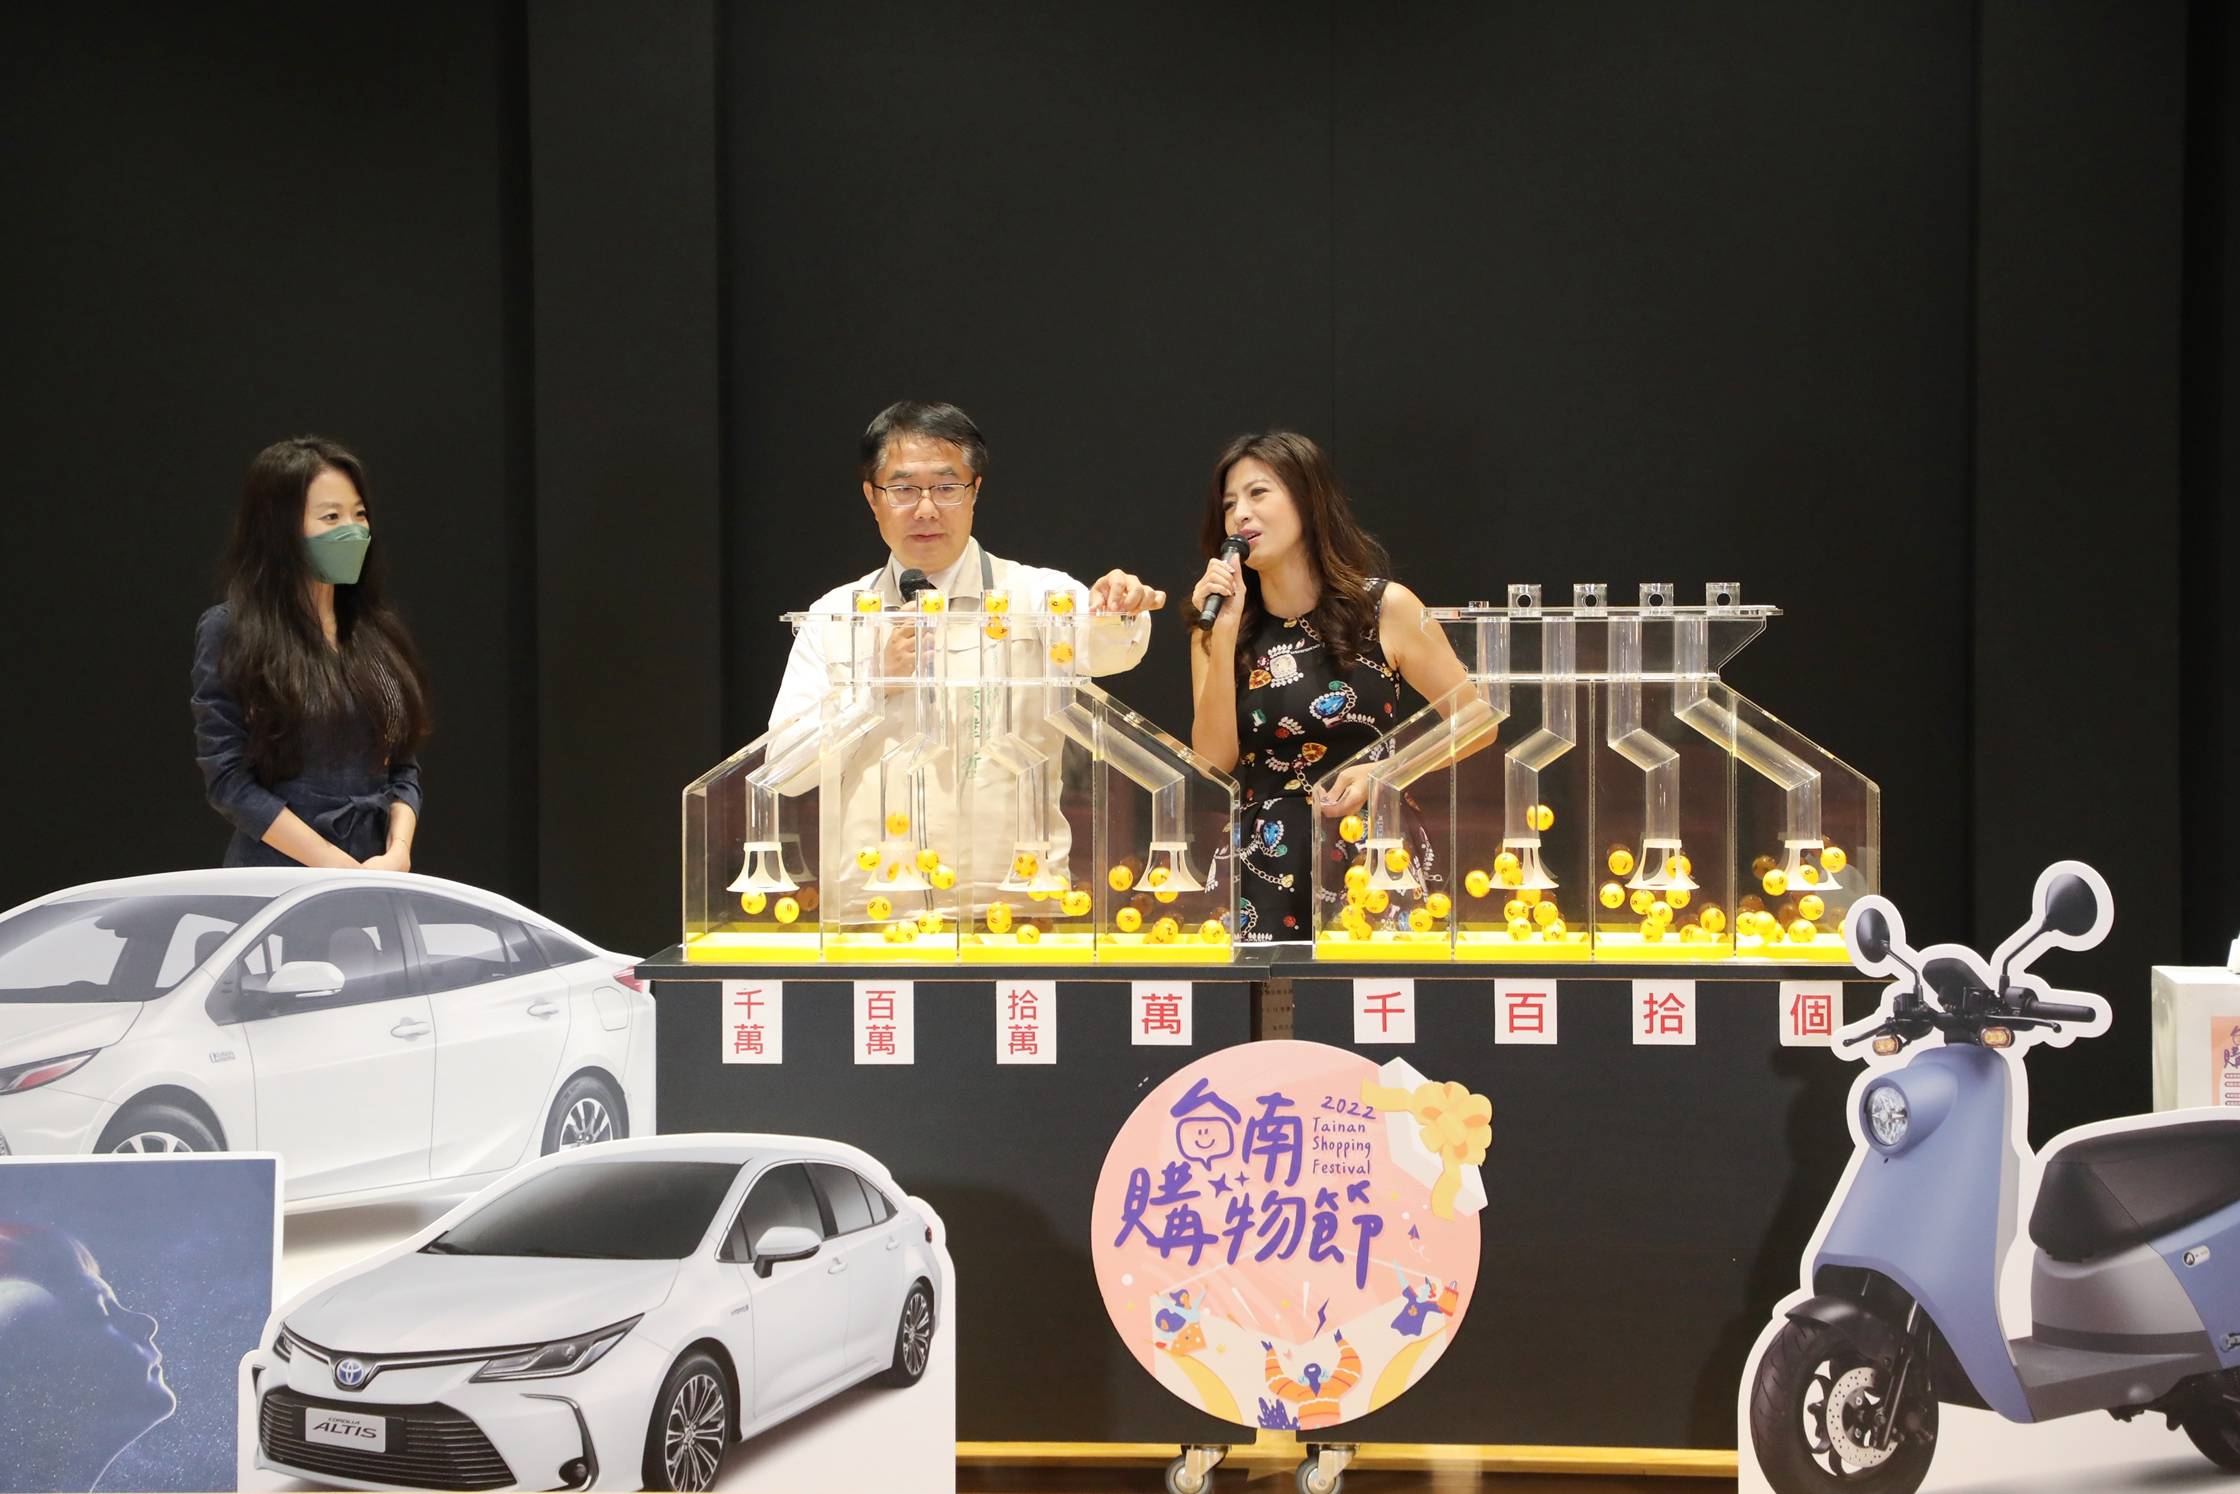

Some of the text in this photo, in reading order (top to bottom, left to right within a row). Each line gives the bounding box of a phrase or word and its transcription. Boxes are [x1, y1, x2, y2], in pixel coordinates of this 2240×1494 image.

[734, 989, 766, 1056] 千萬
[865, 990, 897, 1056] 百萬
[1007, 989, 1040, 1056] 拾萬
[1141, 992, 1183, 1036] 萬
[1362, 991, 1406, 1033] 千
[1504, 992, 1548, 1034] 百
[1643, 992, 1686, 1035] 拾
[1790, 994, 1833, 1036] 個
[1312, 1116, 1366, 1133] Tainan
[1321, 1095, 1377, 1120] 2022
[1312, 1135, 1372, 1158] Shopping
[1312, 1159, 1371, 1175] Festival
[1115, 1159, 1383, 1290] 購物節
[312, 1421, 377, 1439] ALTIS
